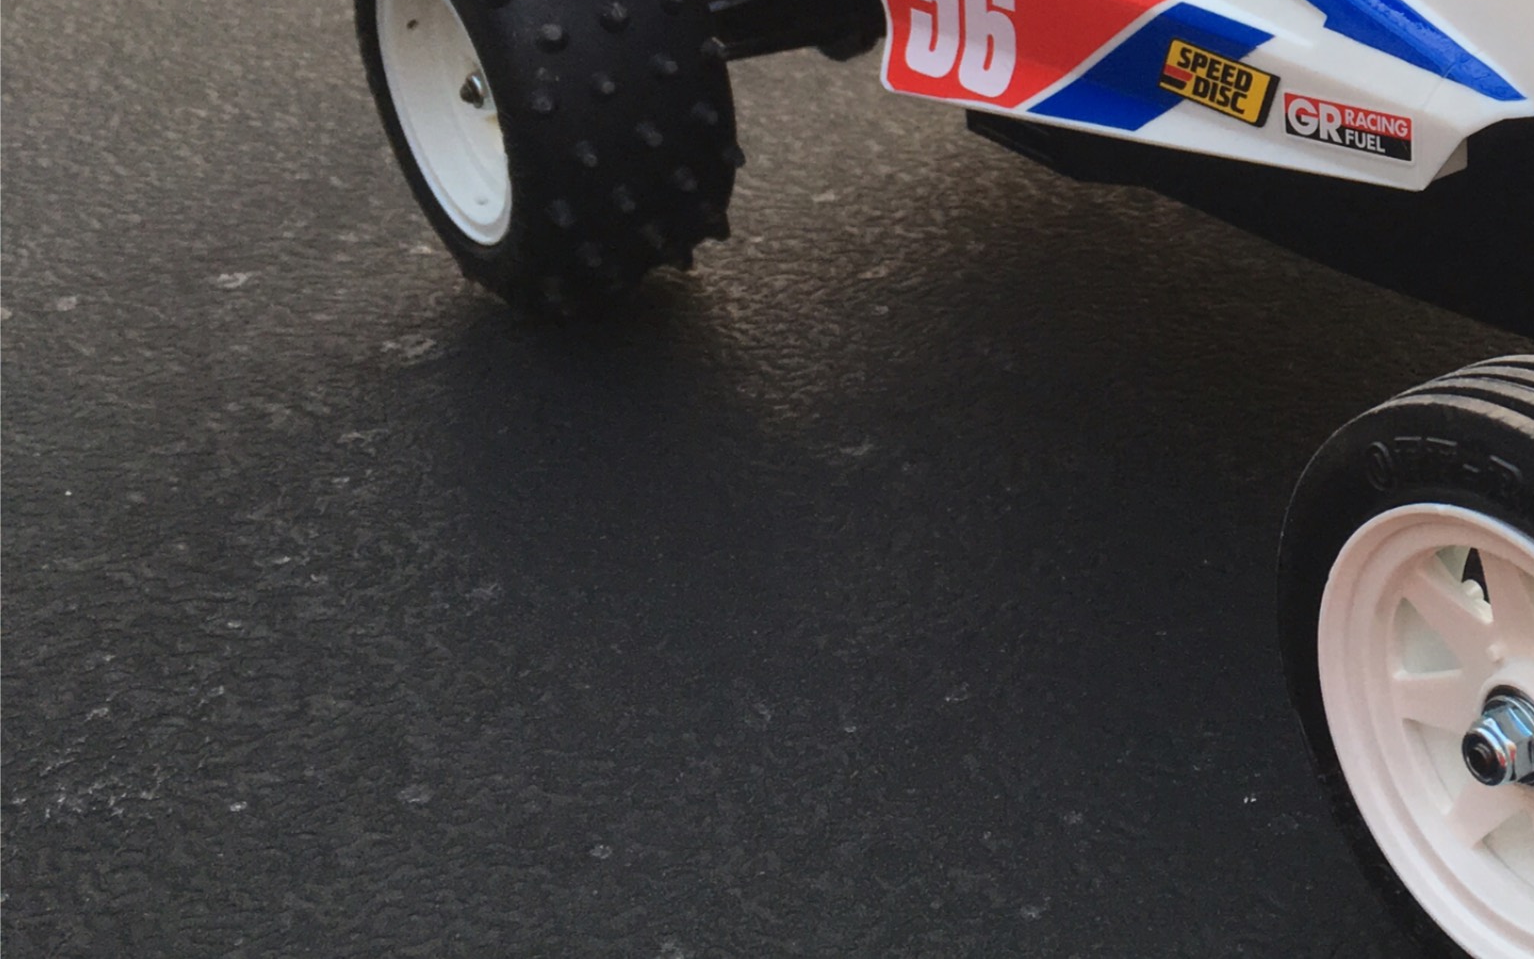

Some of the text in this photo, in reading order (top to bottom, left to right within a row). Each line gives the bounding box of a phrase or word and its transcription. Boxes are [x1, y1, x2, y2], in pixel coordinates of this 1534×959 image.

[1176, 46, 1254, 93] SPEED
[1191, 75, 1249, 115] DISC
[1287, 97, 1409, 144] GR RACING
[1344, 129, 1386, 153] FUEL
